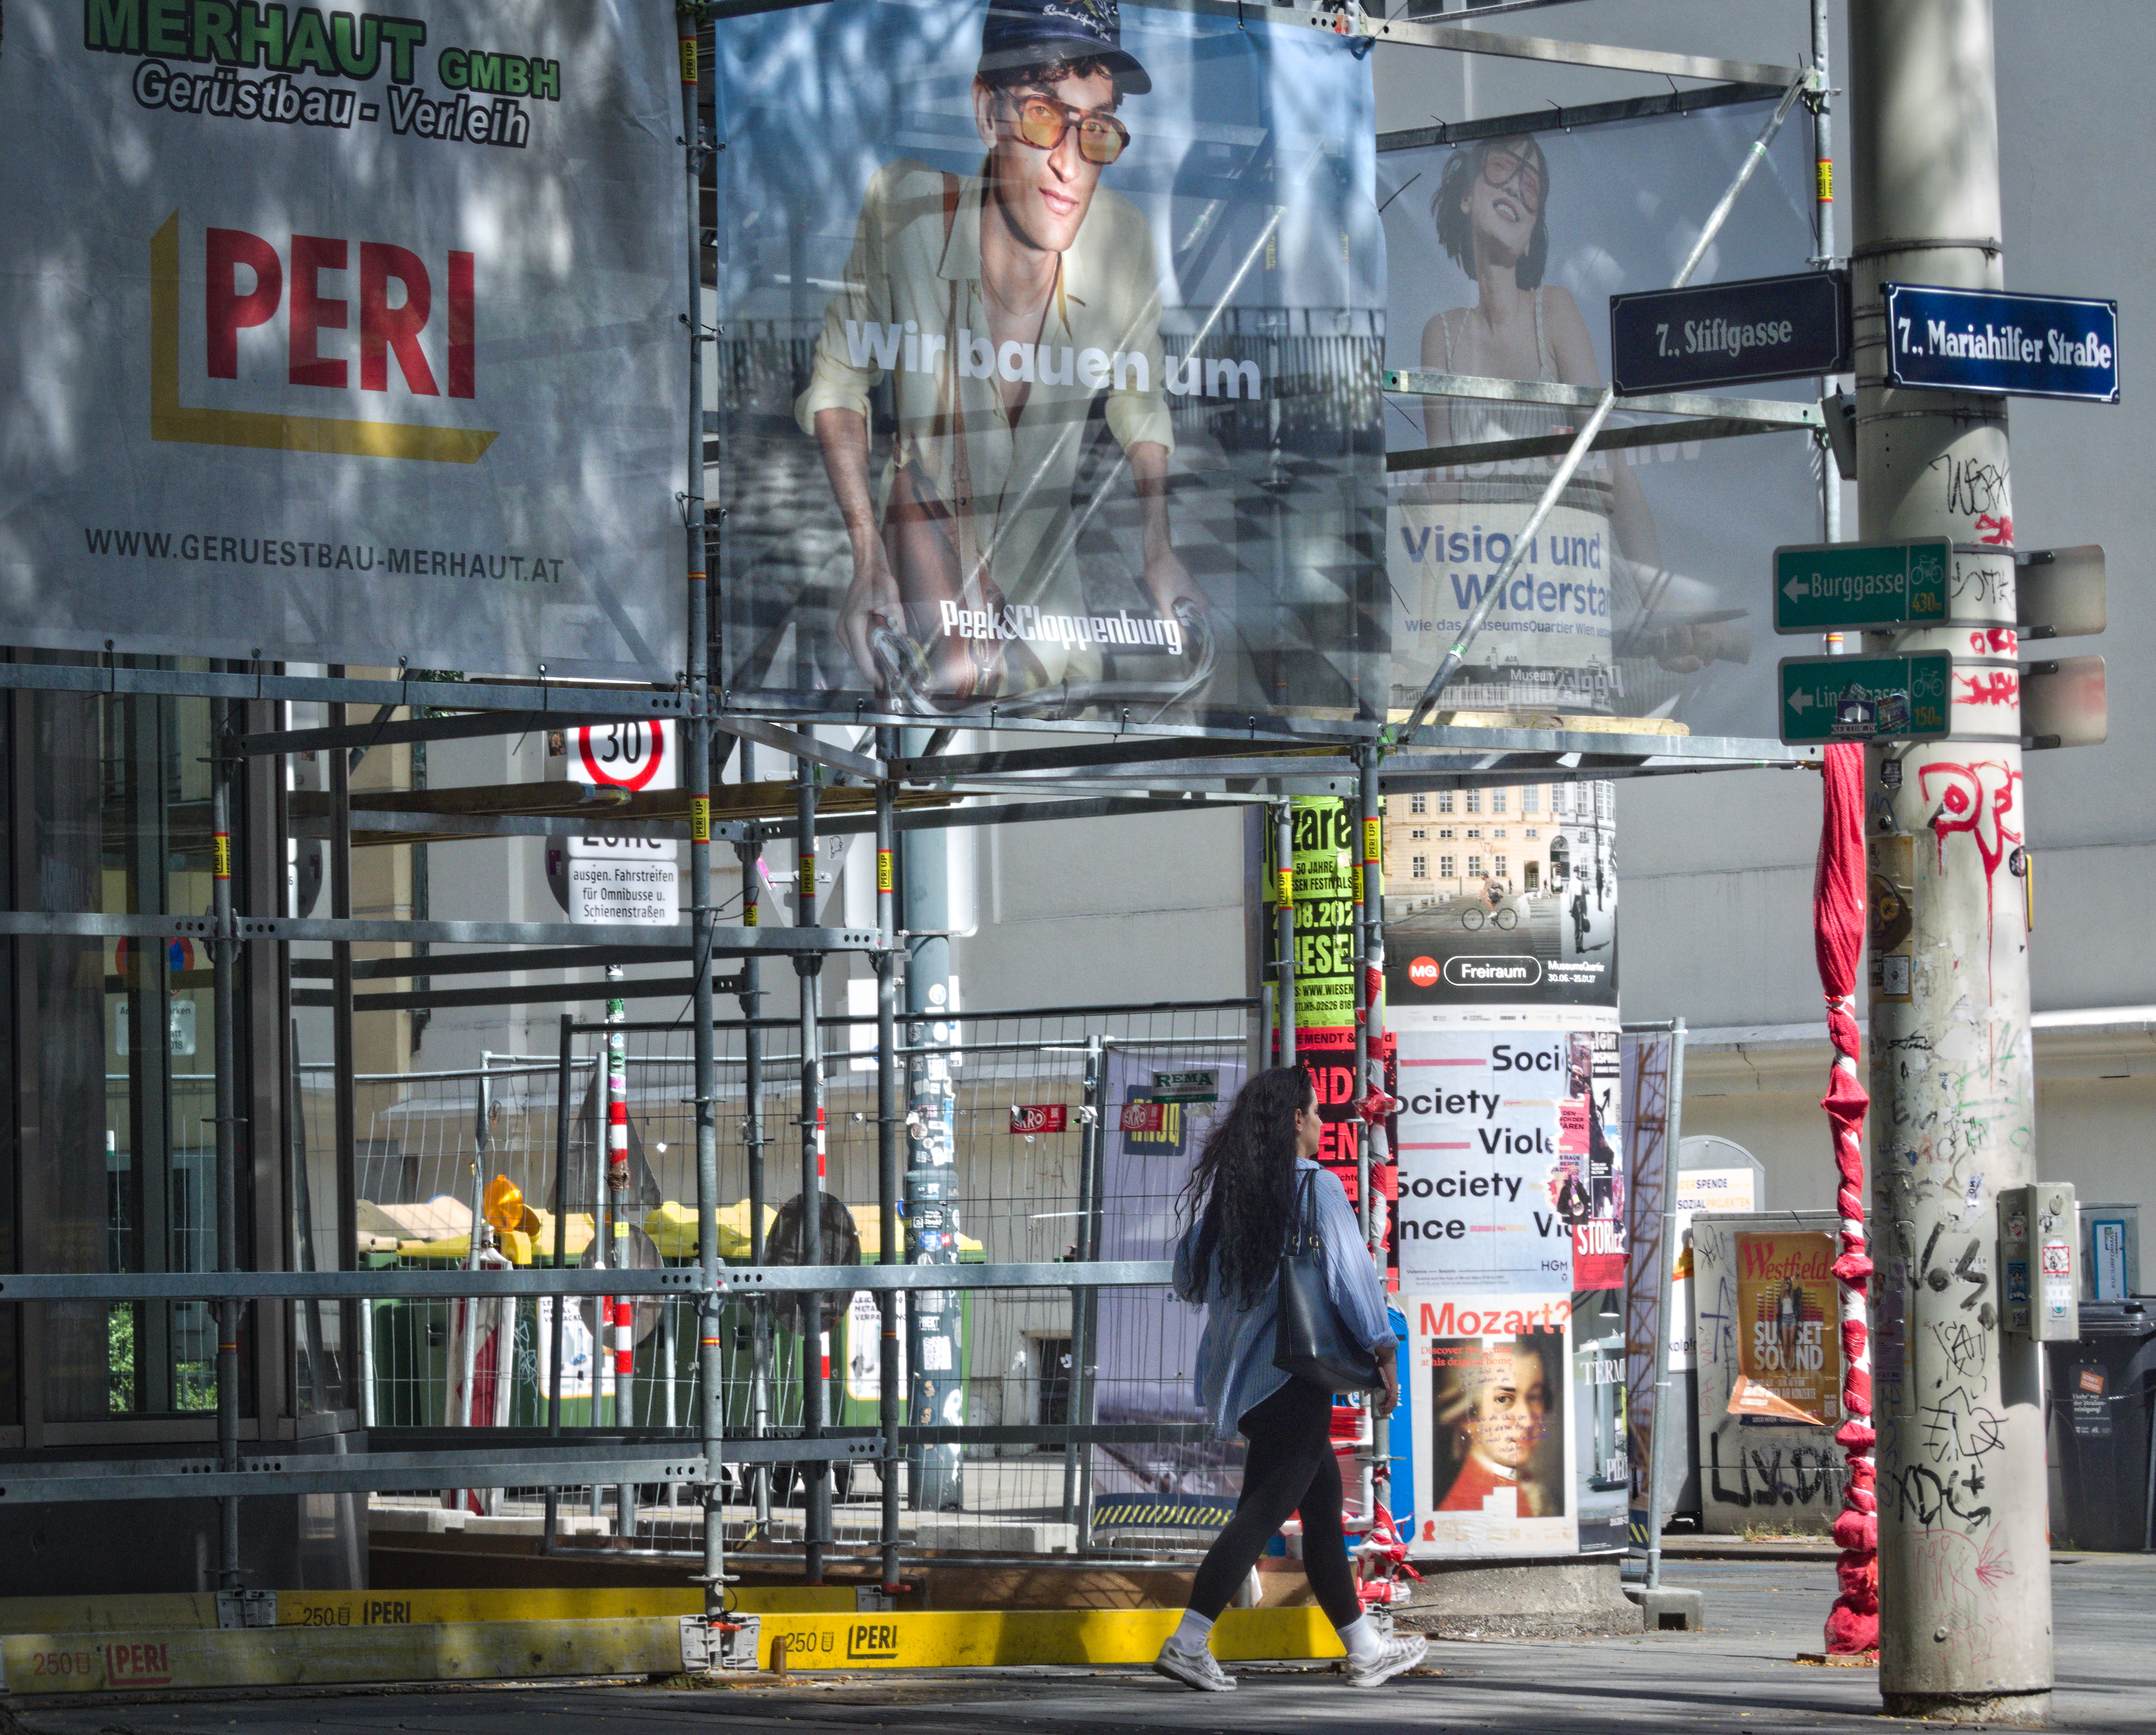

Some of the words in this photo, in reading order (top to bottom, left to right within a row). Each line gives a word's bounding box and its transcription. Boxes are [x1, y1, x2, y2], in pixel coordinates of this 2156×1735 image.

[85, 0, 427, 82] MERHAUT
[438, 47, 560, 101] GMBH
[133, 60, 354, 129] Gerüstbau
[387, 85, 531, 149] Verleih
[206, 226, 475, 399] PERI
[1655, 323, 1681, 358] 7.,
[1684, 318, 1793, 359] Stiftgasse
[1897, 317, 1924, 354] 7.,
[1927, 318, 2044, 364] Mariahilfer
[2047, 328, 2112, 370] Straße
[845, 319, 947, 377] Wir
[955, 327, 1150, 392] bauen
[1164, 354, 1262, 401] um
[84, 527, 564, 584] WWW.GERUESTBAU-MERHAUT.AT
[1400, 525, 1538, 564] Vision
[1550, 533, 1601, 570] und
[1811, 572, 1905, 602] Burggasse
[939, 599, 1184, 657] Peek&Cloppenburg
[1405, 619, 1432, 632] Wie
[1436, 619, 1461, 632] das
[601, 721, 641, 764] 30
[696, 800, 706, 817] UP
[696, 817, 706, 837] PERI
[1369, 822, 1375, 836] UP
[1369, 837, 1377, 857] PERI
[881, 854, 888, 869] UP
[1296, 862, 1307, 875] 50
[1308, 860, 1334, 874] JAHRE
[573, 869, 612, 883] ausgen.
[614, 868, 674, 883] Fahrstreifen
[881, 869, 890, 888] PERI
[1279, 873, 1286, 886] UP
[583, 888, 599, 901] für
[600, 888, 653, 901] Omnibusse
[656, 892, 666, 901] u.
[1279, 886, 1287, 904] PERI
[583, 904, 665, 918] Schienenstraßen
[1411, 965, 1438, 978] MQ
[1461, 963, 1527, 979] Freiraum
[1548, 959, 1605, 972] MuseumsQuartier
[1304, 1033, 1343, 1044] MENDT
[1154, 1072, 1214, 1087] REMA
[1541, 1260, 1568, 1271] HGM
[1742, 1241, 1830, 1281] Westfield
[1420, 1300, 1572, 1335] Mozart?
[1420, 1346, 1464, 1355] Discover
[1466, 1345, 1480, 1354] the
[1482, 1346, 1513, 1356] genius
[1421, 1358, 1429, 1366] at
[1431, 1357, 1445, 1367] his
[1447, 1357, 1484, 1368] original
[303, 1607, 334, 1627] 250
[371, 1601, 411, 1624] PERI
[786, 1632, 817, 1652] 250
[856, 1625, 898, 1649] PERI
[33, 1652, 72, 1676] 250
[115, 1643, 169, 1673] PERI
